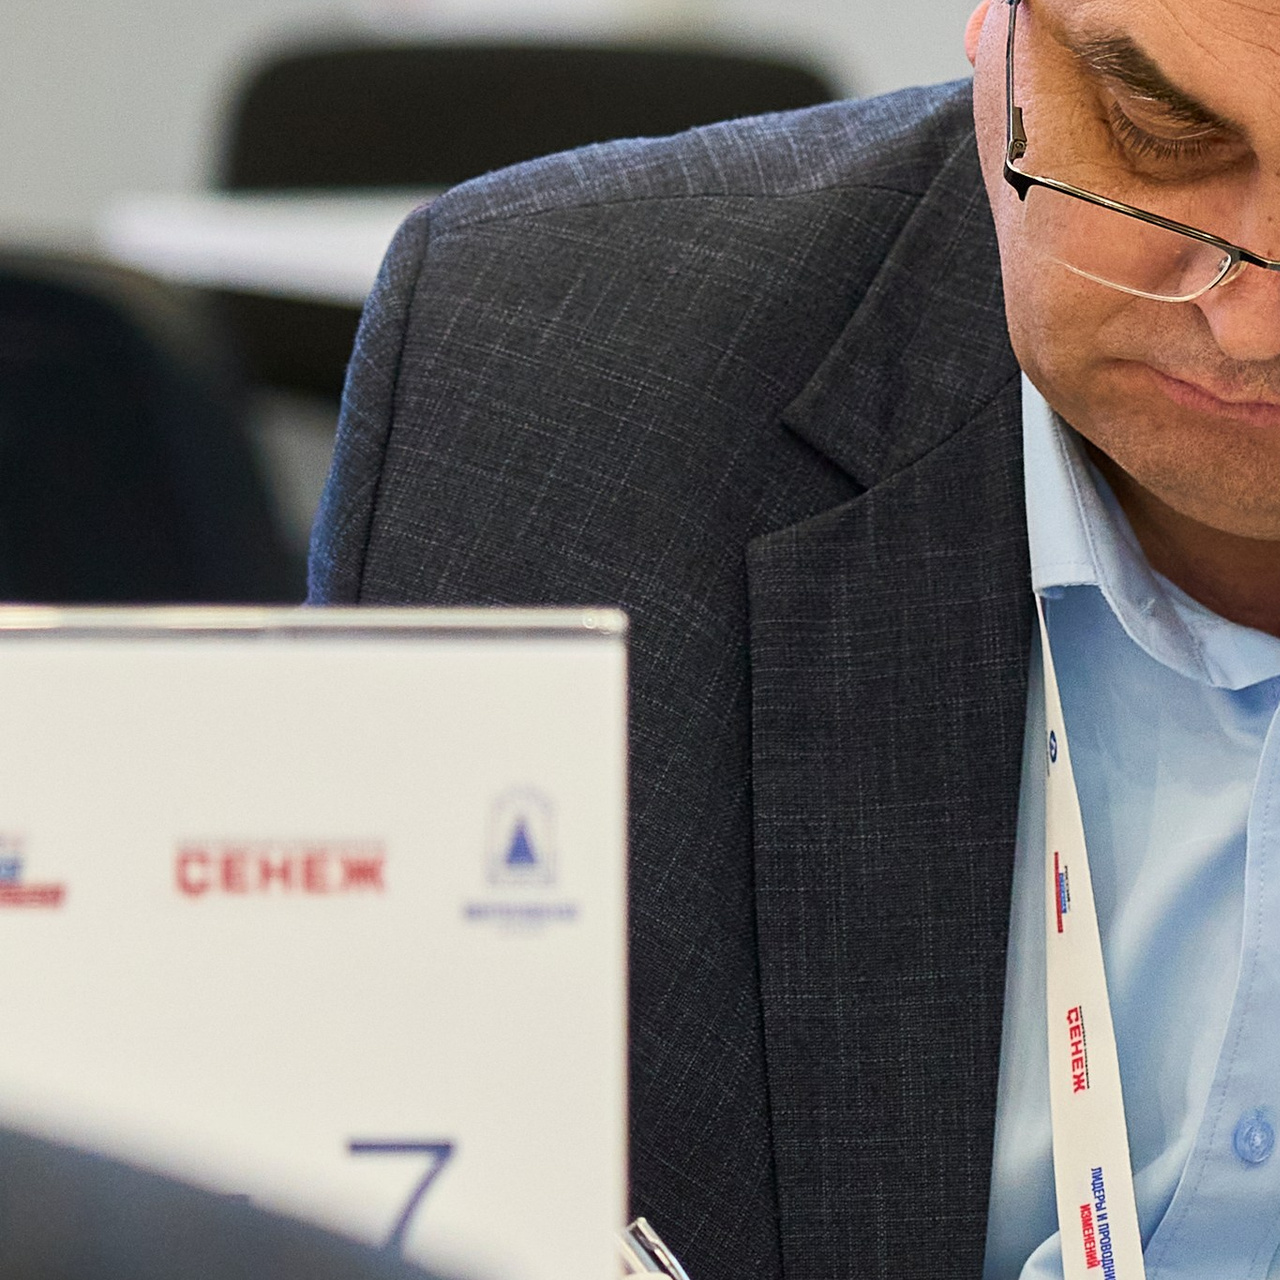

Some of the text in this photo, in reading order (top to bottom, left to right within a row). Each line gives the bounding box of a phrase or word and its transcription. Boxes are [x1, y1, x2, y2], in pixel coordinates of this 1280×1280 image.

[175, 846, 386, 898] СЕНЕЖ
[1067, 1007, 1085, 1093] СЕНЕЖ
[348, 1140, 452, 1248] 7
[1091, 1167, 1106, 1211] ЛИДЕРЫ
[1097, 1213, 1107, 1221] И
[1080, 1204, 1100, 1269] ИЗМЕНЕНИЙ
